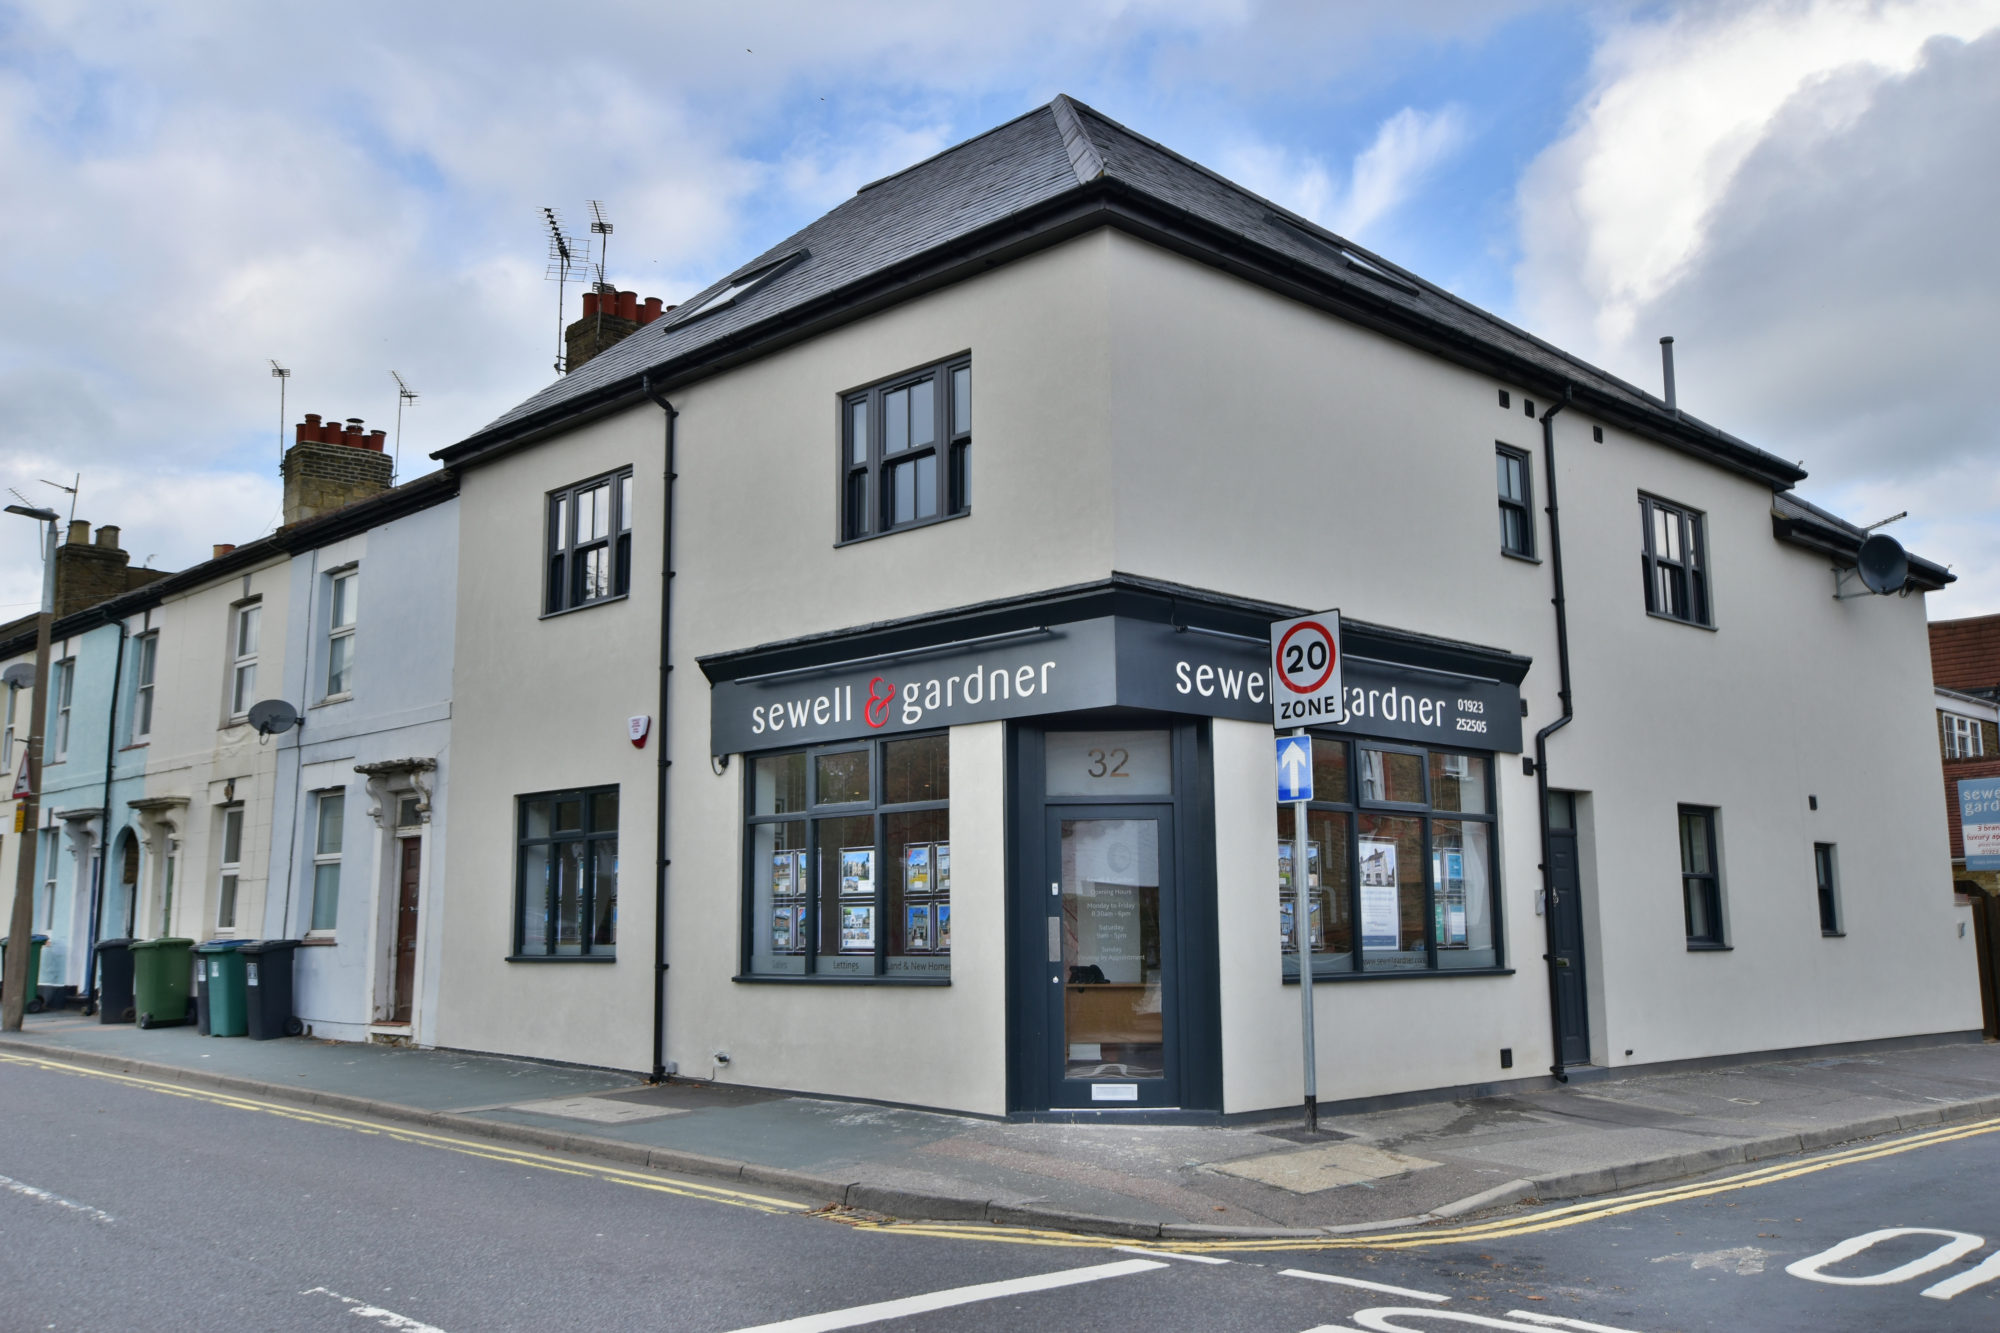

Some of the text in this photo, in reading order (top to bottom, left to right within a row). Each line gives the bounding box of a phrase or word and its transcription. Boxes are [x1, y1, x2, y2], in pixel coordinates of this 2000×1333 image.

[1286, 641, 1327, 674] 20
[1176, 661, 1273, 705] sewel
[752, 661, 1056, 734] sewell & gardner
[1457, 699, 1484, 714] 01923
[1281, 696, 1335, 719] ZONE
[1456, 718, 1488, 733] 252505
[1087, 748, 1130, 778] 32
[1087, 902, 1109, 911] Monday
[1118, 902, 1136, 911] Friday
[832, 960, 860, 972] Lettings
[903, 961, 910, 971] &
[911, 961, 927, 971] New
